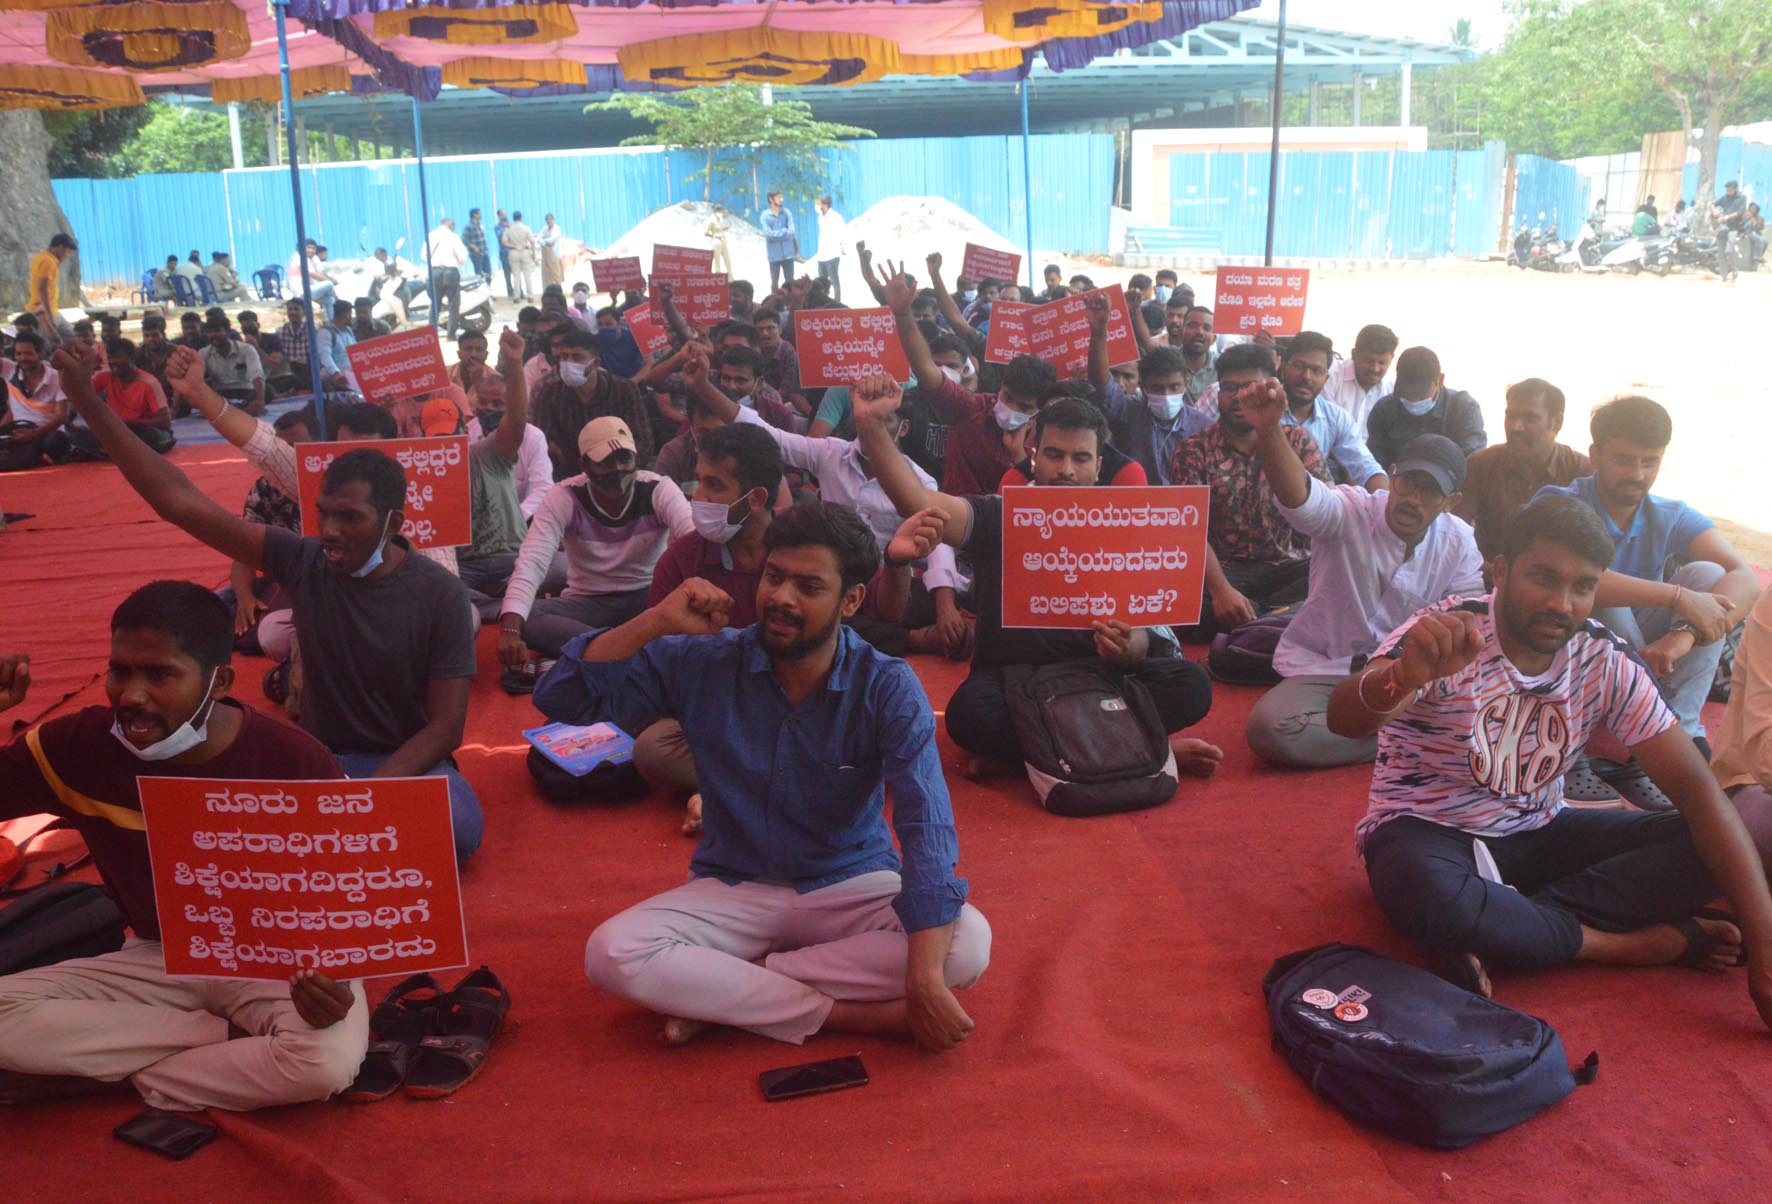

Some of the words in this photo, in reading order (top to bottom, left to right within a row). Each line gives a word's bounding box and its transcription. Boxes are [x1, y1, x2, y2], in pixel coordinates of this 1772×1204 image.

[800, 314, 853, 338] ಅಕ್ಕಿಯಲ್ಲಿ
[860, 312, 896, 334] ಕಲ್ಲಿದ್ದ
[822, 336, 885, 361] ಅಕ್ಕಿಯನ್ನೇ
[1013, 501, 1199, 540] ನ್ಯಾಯಯುತವಾಗಿ
[1022, 545, 1188, 584] ಆಯ್ಕೆಯಾದವರು
[1029, 591, 1117, 617] ಬಲಿಪಶು
[1128, 588, 1178, 614] ಏಕೆ?
[1468, 693, 1569, 797] SK8
[204, 787, 298, 814] ನೂರು
[317, 787, 374, 814] ಜನ
[192, 825, 398, 857] ಅಪರಾಧಿಗಳಿಗೆ
[174, 862, 433, 902] ಶಿಕ್ಷೆಯಾಗದಿದ್ದರೂ,
[184, 903, 236, 937] ಒಬ್ಬ
[251, 899, 430, 931] ನಿರಪರಾಧಿಗೆ
[188, 934, 437, 971] ಶಿಕ್ಷೆಯಾಗಬಾರದು
